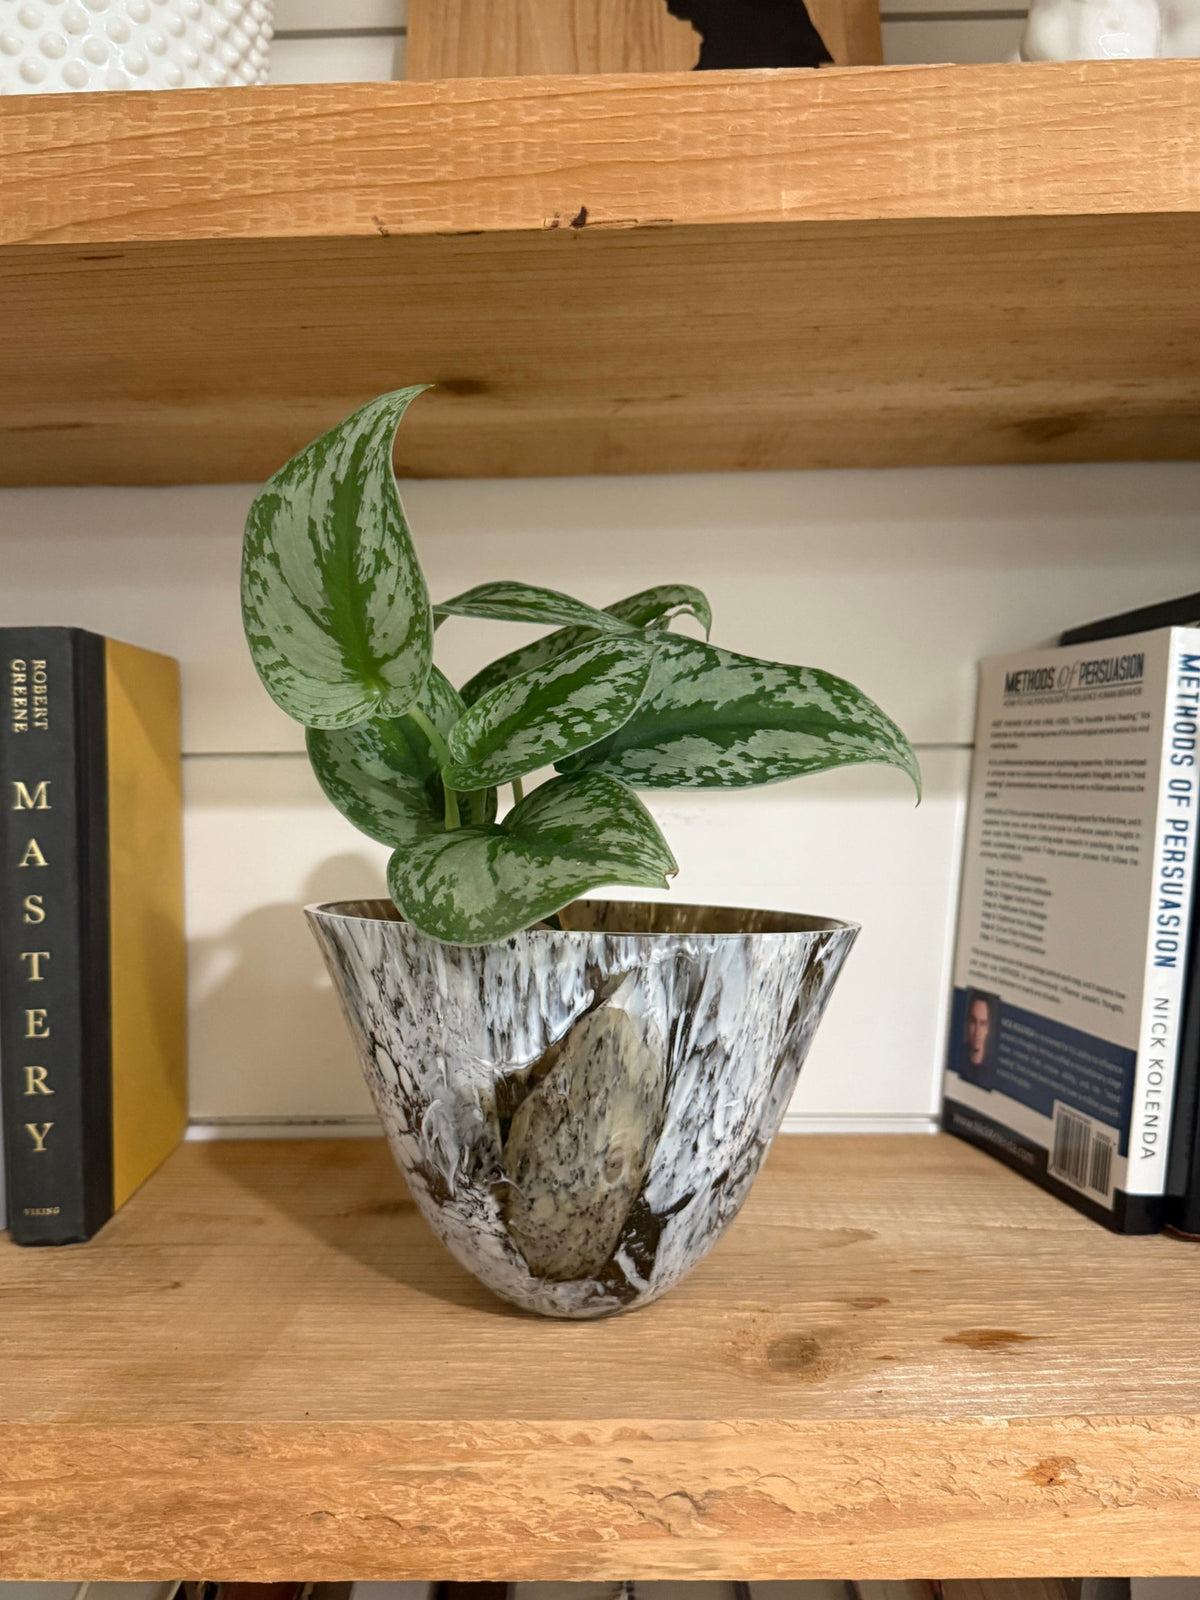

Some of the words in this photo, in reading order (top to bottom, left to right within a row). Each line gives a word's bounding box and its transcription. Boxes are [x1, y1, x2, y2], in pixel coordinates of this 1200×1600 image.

[11, 659, 28, 733] GREENE
[32, 659, 49, 730] ROBERT
[1004, 666, 1056, 692] METHODS
[1078, 652, 1145, 686] PERSUASION
[1170, 654, 1200, 767] METHODS
[1168, 779, 1192, 808] OF
[1154, 818, 1189, 968] PERSUASION
[11, 780, 54, 1152] MASTERY
[1149, 997, 1169, 1048] NICK
[1140, 1058, 1165, 1160] KOLENDA
[24, 1206, 61, 1216] VIKING
